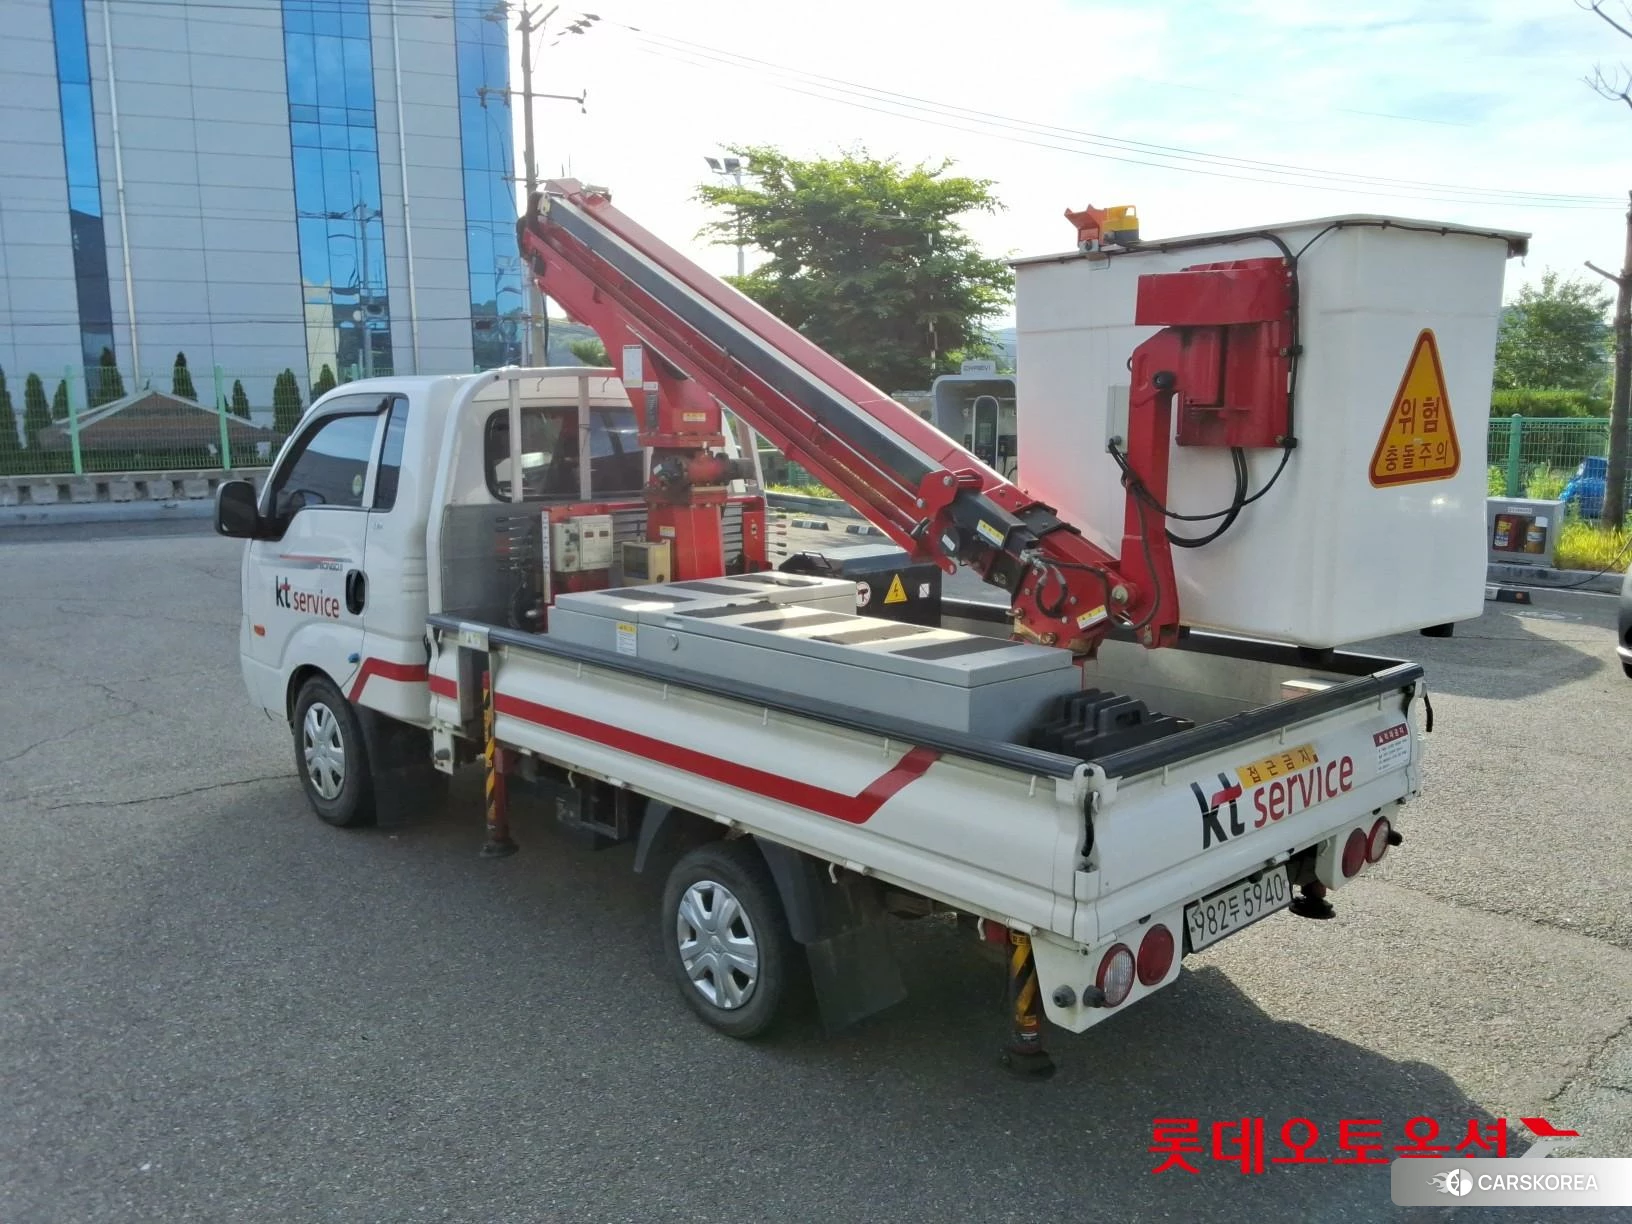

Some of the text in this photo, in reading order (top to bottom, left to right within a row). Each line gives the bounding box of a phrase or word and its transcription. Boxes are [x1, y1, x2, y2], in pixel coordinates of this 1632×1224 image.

[1399, 396, 1440, 434] 위험
[1385, 440, 1448, 471] 충돌주의
[275, 575, 340, 618] kt service
[1190, 755, 1354, 850] kt service
[1243, 873, 1284, 918] 5940
